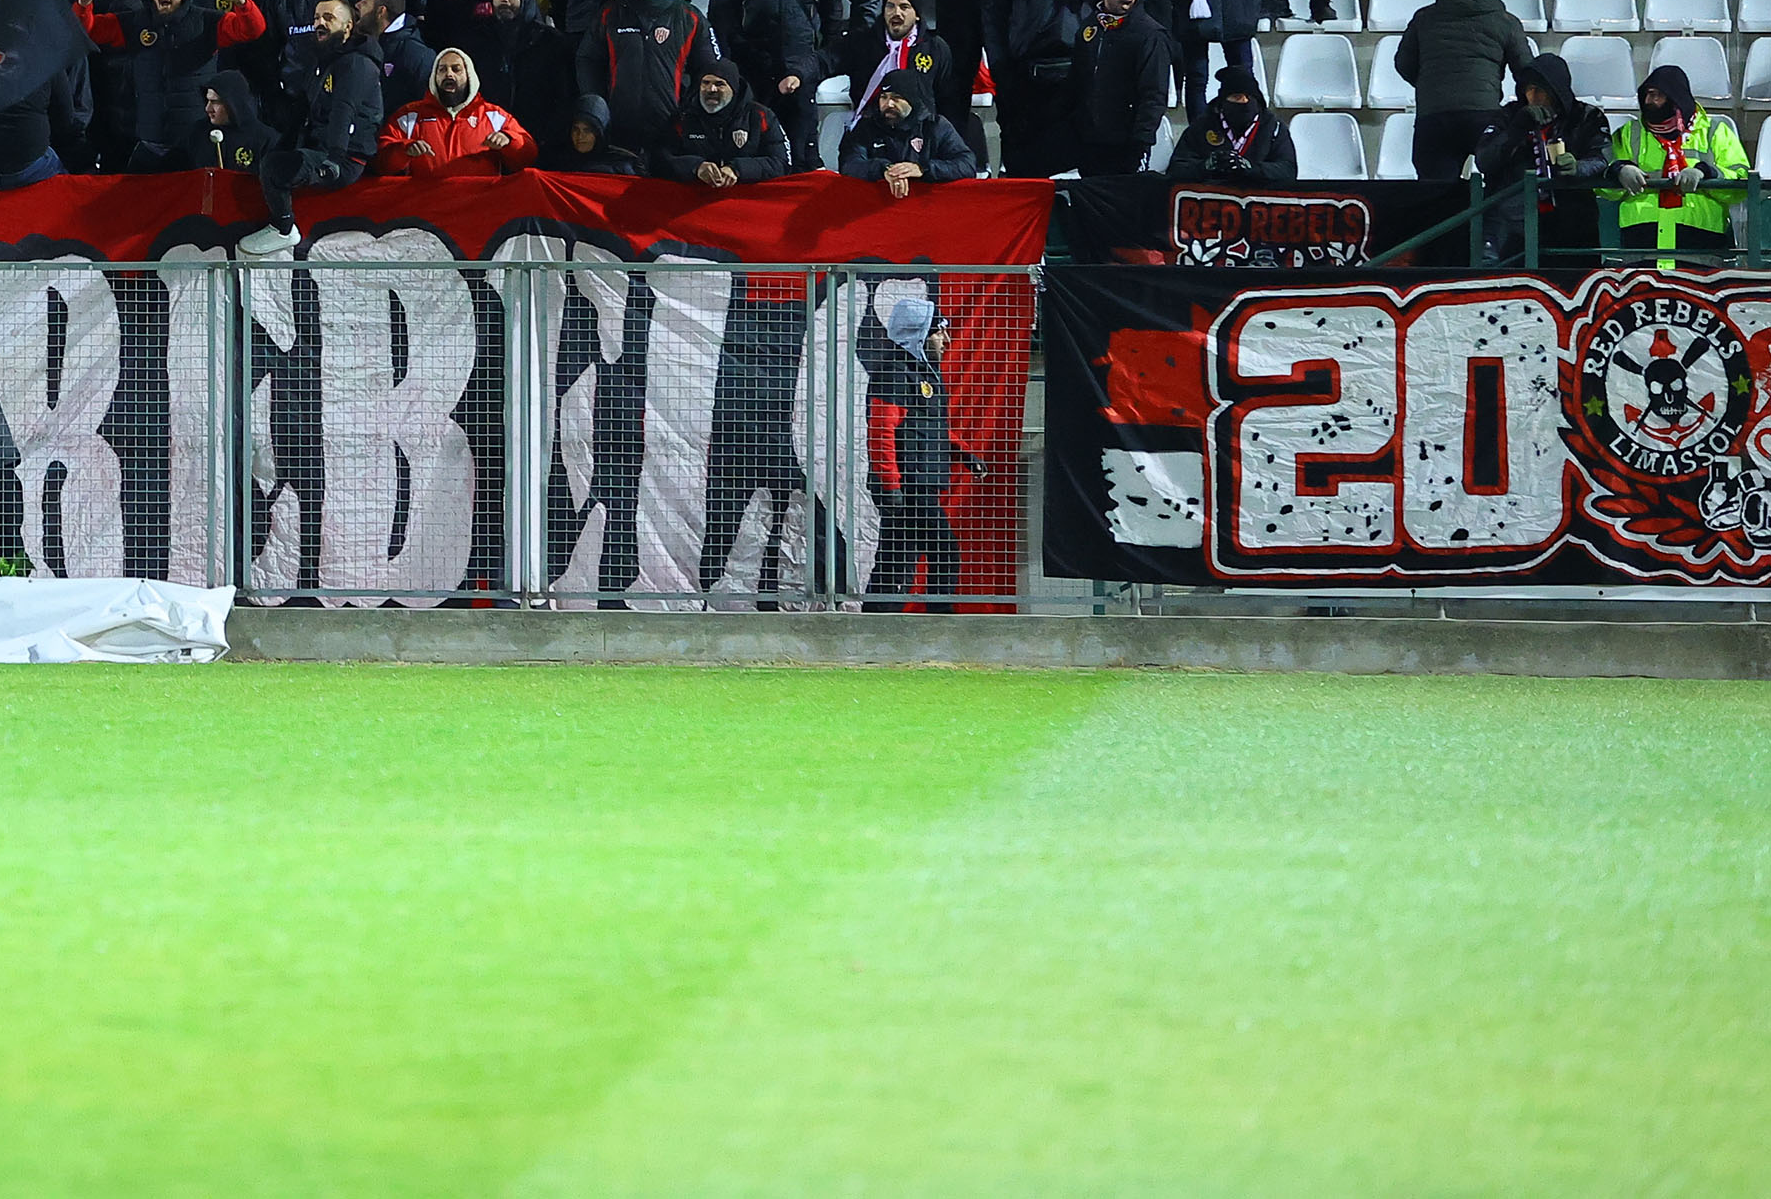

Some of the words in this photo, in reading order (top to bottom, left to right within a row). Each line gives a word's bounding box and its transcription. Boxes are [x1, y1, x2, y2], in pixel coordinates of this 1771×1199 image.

[1179, 200, 1242, 240] RED
[1250, 202, 1363, 243] REBELS
[1583, 318, 1625, 378] RED
[1630, 298, 1743, 361] REBELS
[1236, 299, 1560, 550] 20
[1608, 421, 1743, 476] LIMASSOL
